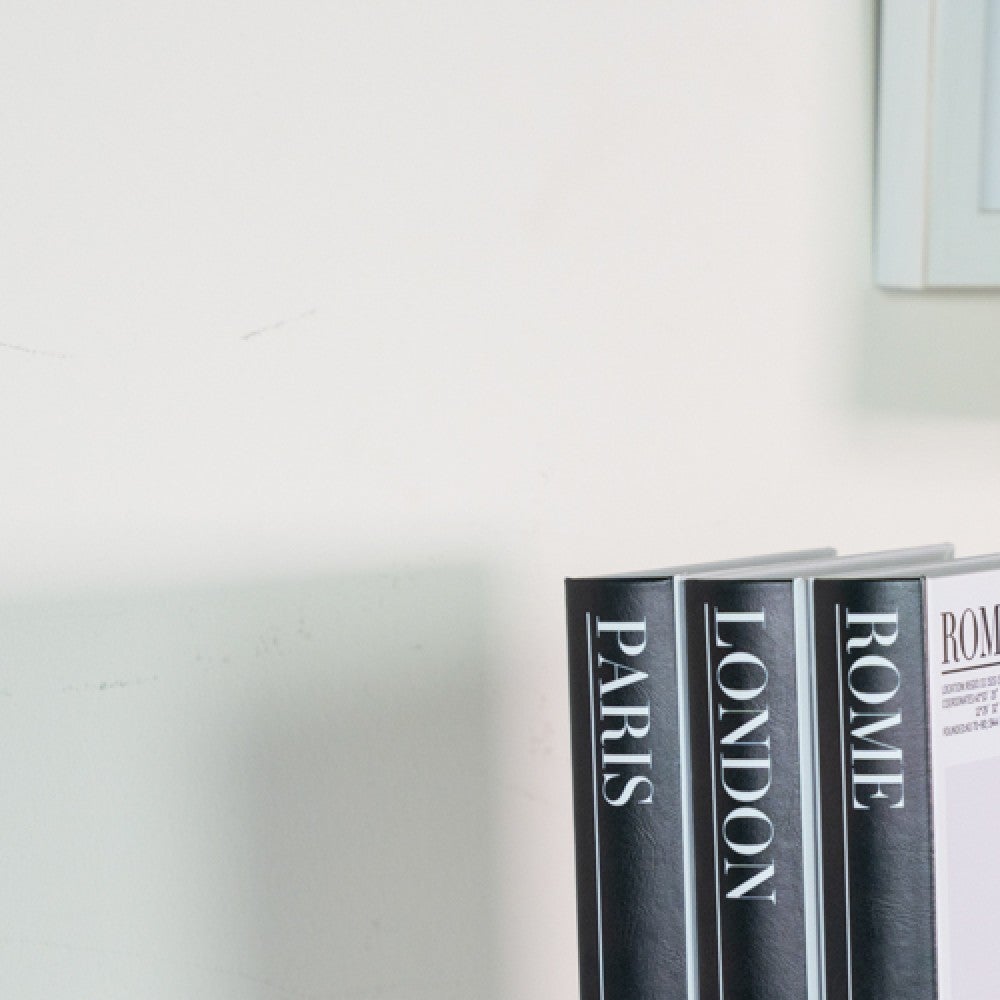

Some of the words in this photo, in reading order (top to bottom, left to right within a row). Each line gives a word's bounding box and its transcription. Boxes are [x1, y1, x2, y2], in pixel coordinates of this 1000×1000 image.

[596, 616, 654, 807] PARIS
[713, 606, 777, 905] LONDON
[846, 608, 905, 811] ROME
